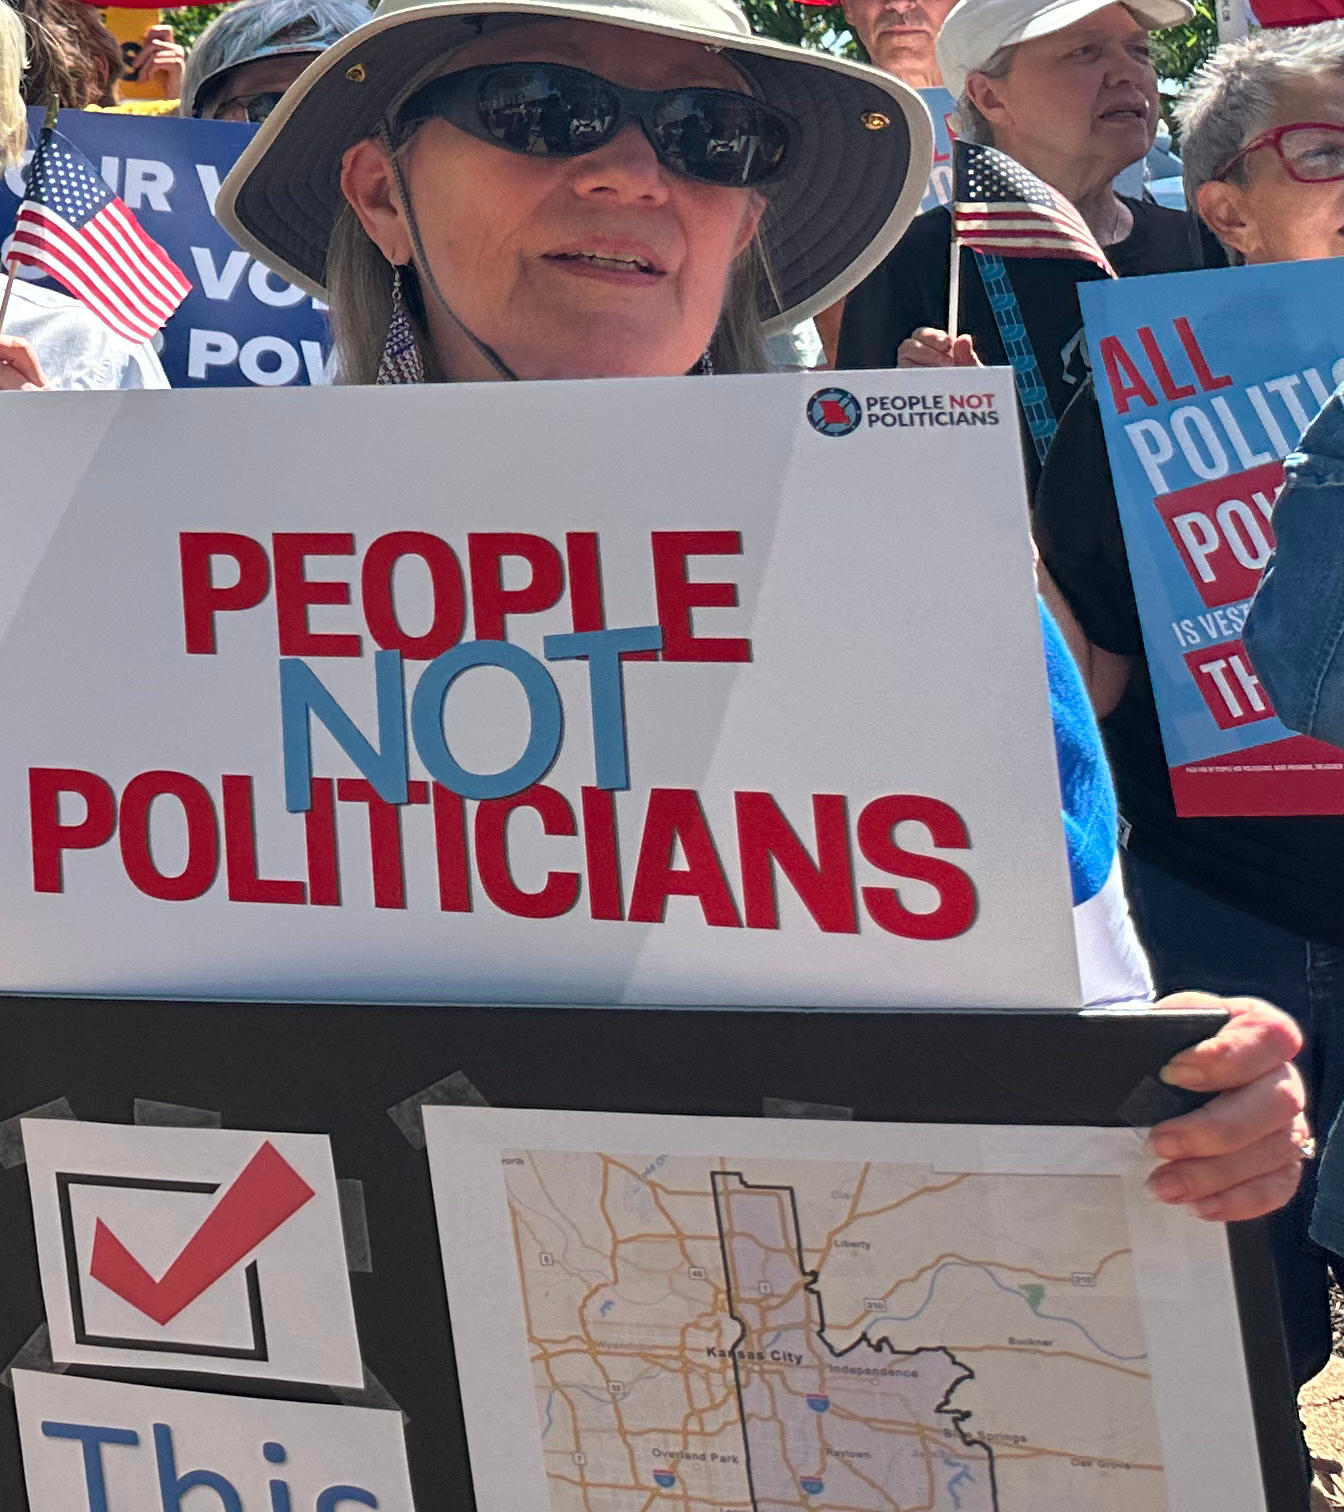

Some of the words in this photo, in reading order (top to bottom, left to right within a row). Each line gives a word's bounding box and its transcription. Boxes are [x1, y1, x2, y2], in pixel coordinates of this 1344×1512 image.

[1098, 315, 1232, 415] ALL
[865, 394, 946, 415] PEOPLE
[948, 392, 996, 411] NOT
[866, 407, 1000, 431] POLITICIANS
[179, 530, 753, 664] PEOPLE
[279, 625, 662, 814] NOT
[27, 766, 981, 940] POLITICIANS
[834, 1240, 871, 1250] Liberty
[706, 1346, 765, 1360] Kansas
[770, 1350, 803, 1365] City
[829, 1364, 918, 1378] Independence
[652, 1448, 706, 1462] Overland
[711, 1452, 740, 1464] Park
